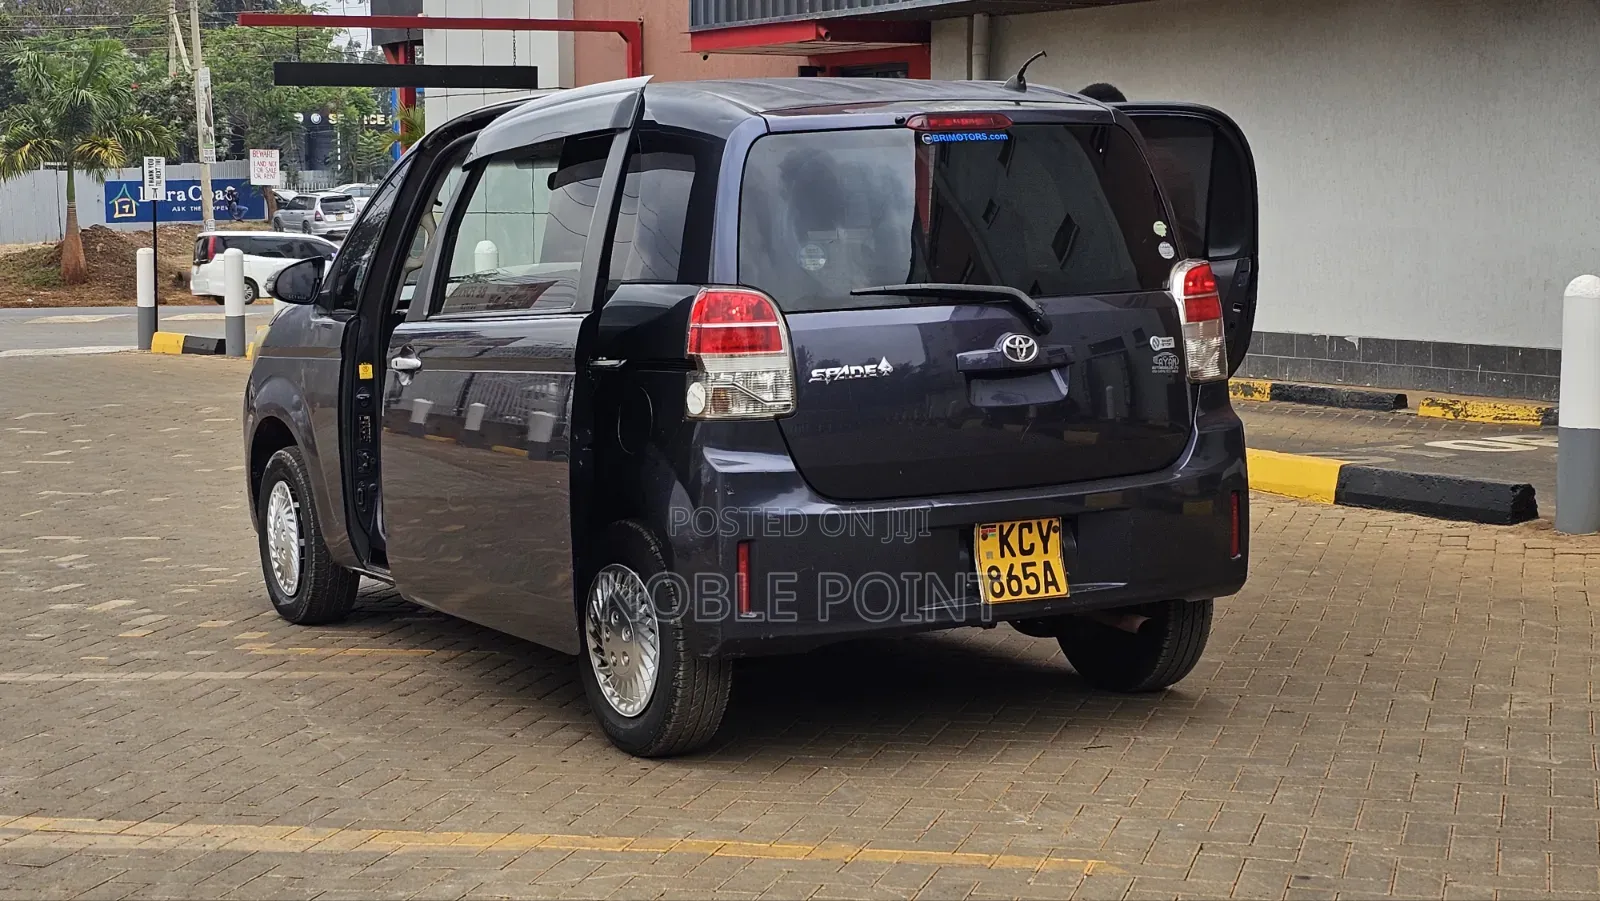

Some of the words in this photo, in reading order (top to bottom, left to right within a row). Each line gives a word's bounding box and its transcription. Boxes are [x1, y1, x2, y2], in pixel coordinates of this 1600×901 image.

[931, 132, 1009, 143] BRIMOTORS.com
[808, 364, 878, 384] SPADE
[998, 520, 1054, 559] KCY
[987, 560, 1061, 599] 865A
